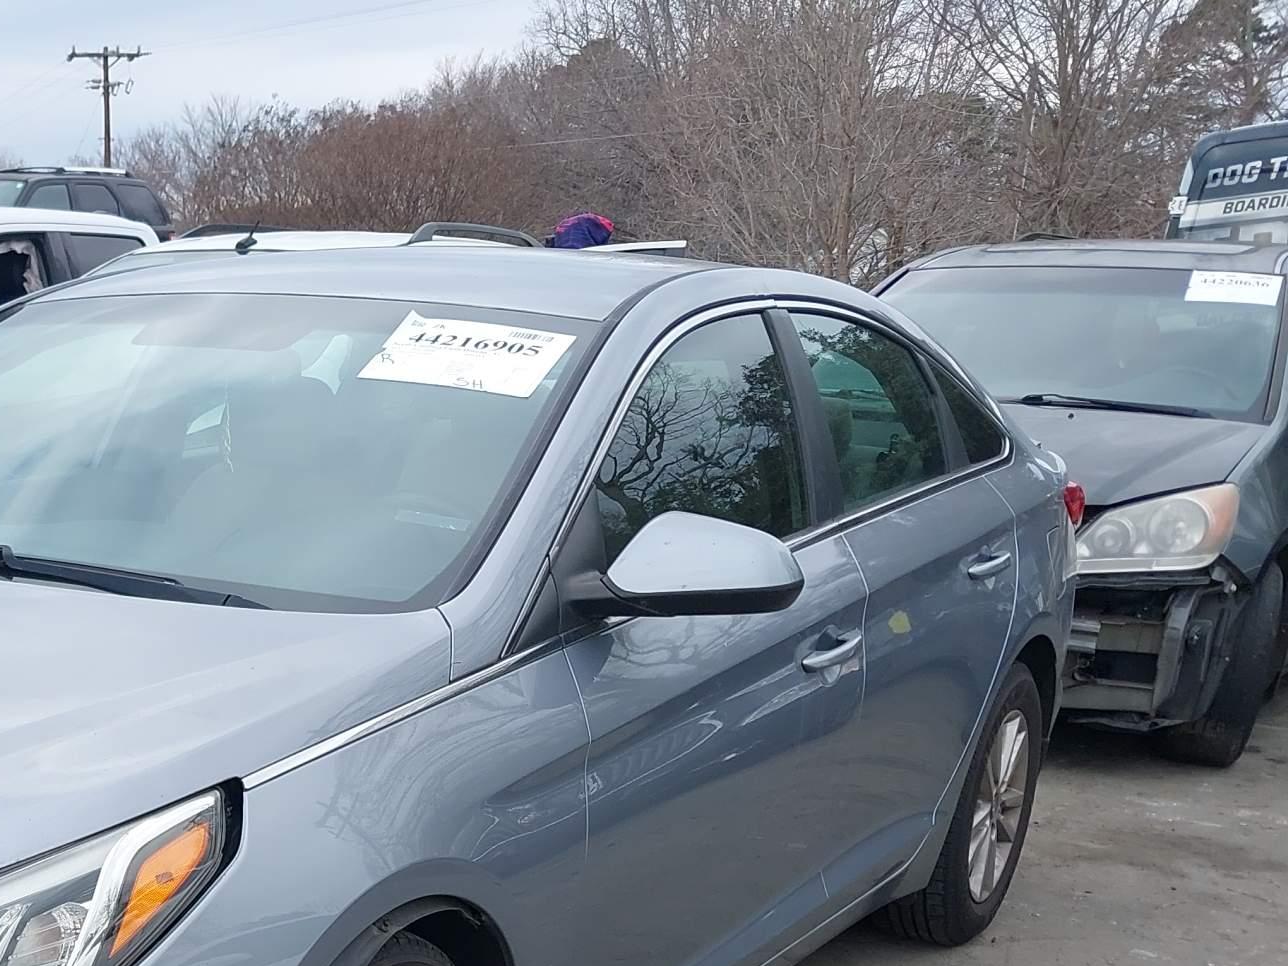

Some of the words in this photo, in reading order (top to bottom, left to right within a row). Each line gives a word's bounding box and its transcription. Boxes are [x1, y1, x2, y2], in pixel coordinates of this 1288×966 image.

[1205, 160, 1263, 189] DOG
[1268, 155, 1288, 180] T
[1223, 194, 1288, 215] BOARDI
[409, 331, 544, 357] 44216905
